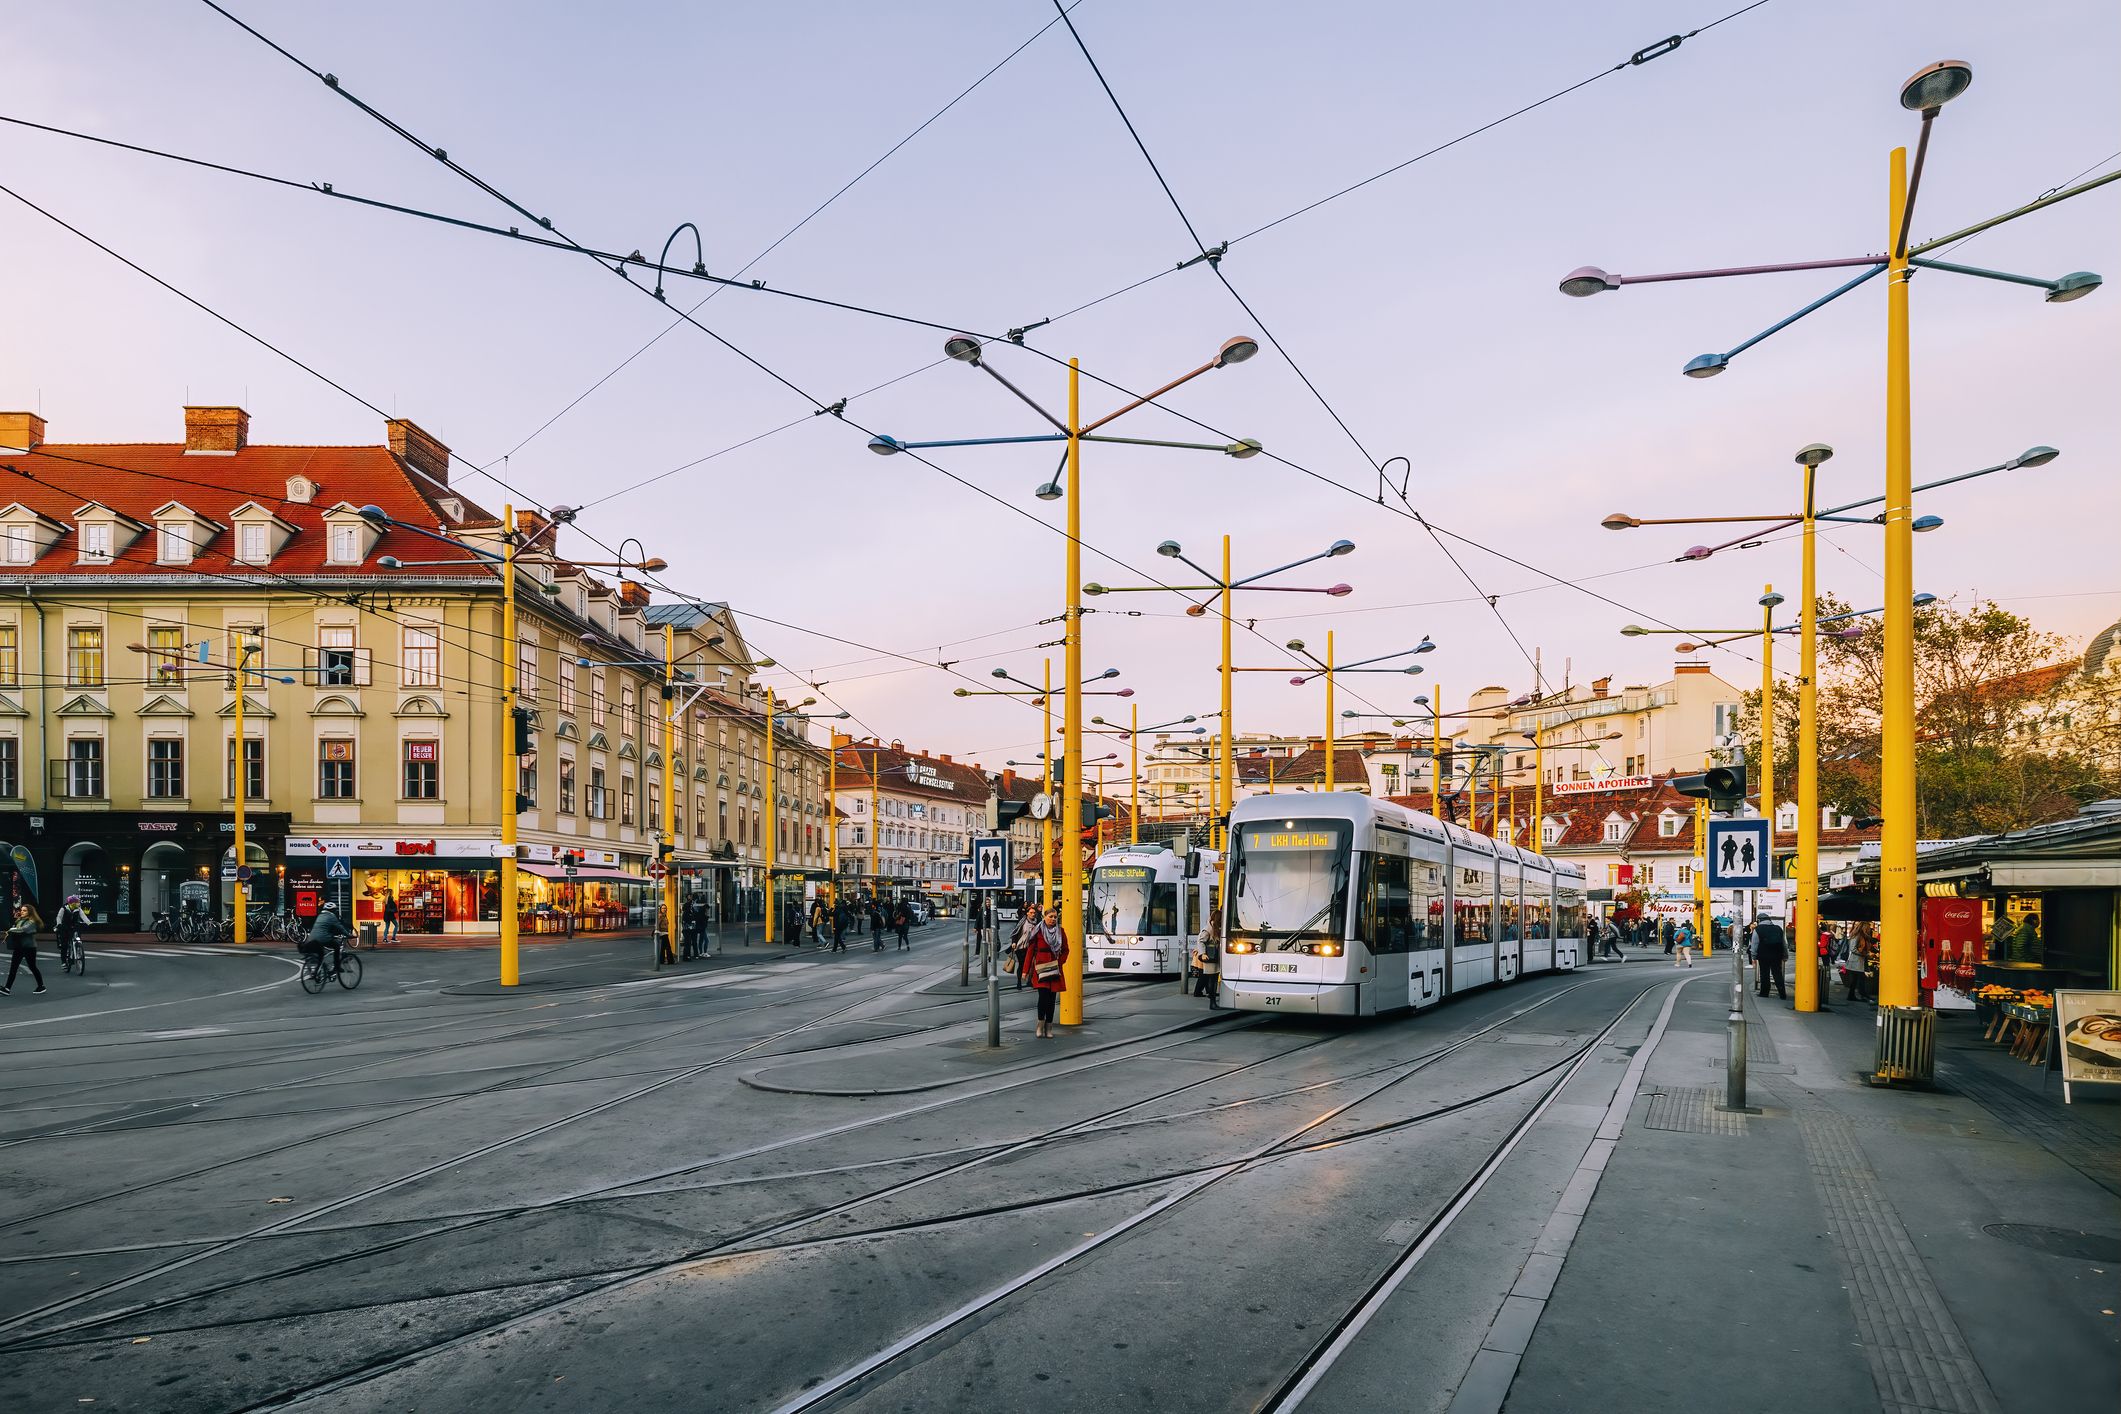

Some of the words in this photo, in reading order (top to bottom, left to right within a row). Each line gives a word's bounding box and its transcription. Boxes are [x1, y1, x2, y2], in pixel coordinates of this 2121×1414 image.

[1555, 782, 1595, 792] SONNEN
[138, 822, 178, 831] TASTY
[219, 823, 257, 832] DOTS
[1253, 834, 1260, 848] 7
[1271, 834, 1288, 847] LKH
[1312, 834, 1328, 846] Uni
[1648, 903, 1677, 912] Walter
[1944, 911, 1970, 919] Coca-Cola
[1262, 964, 1297, 973] GRAZ
[1265, 996, 1282, 1005] 217
